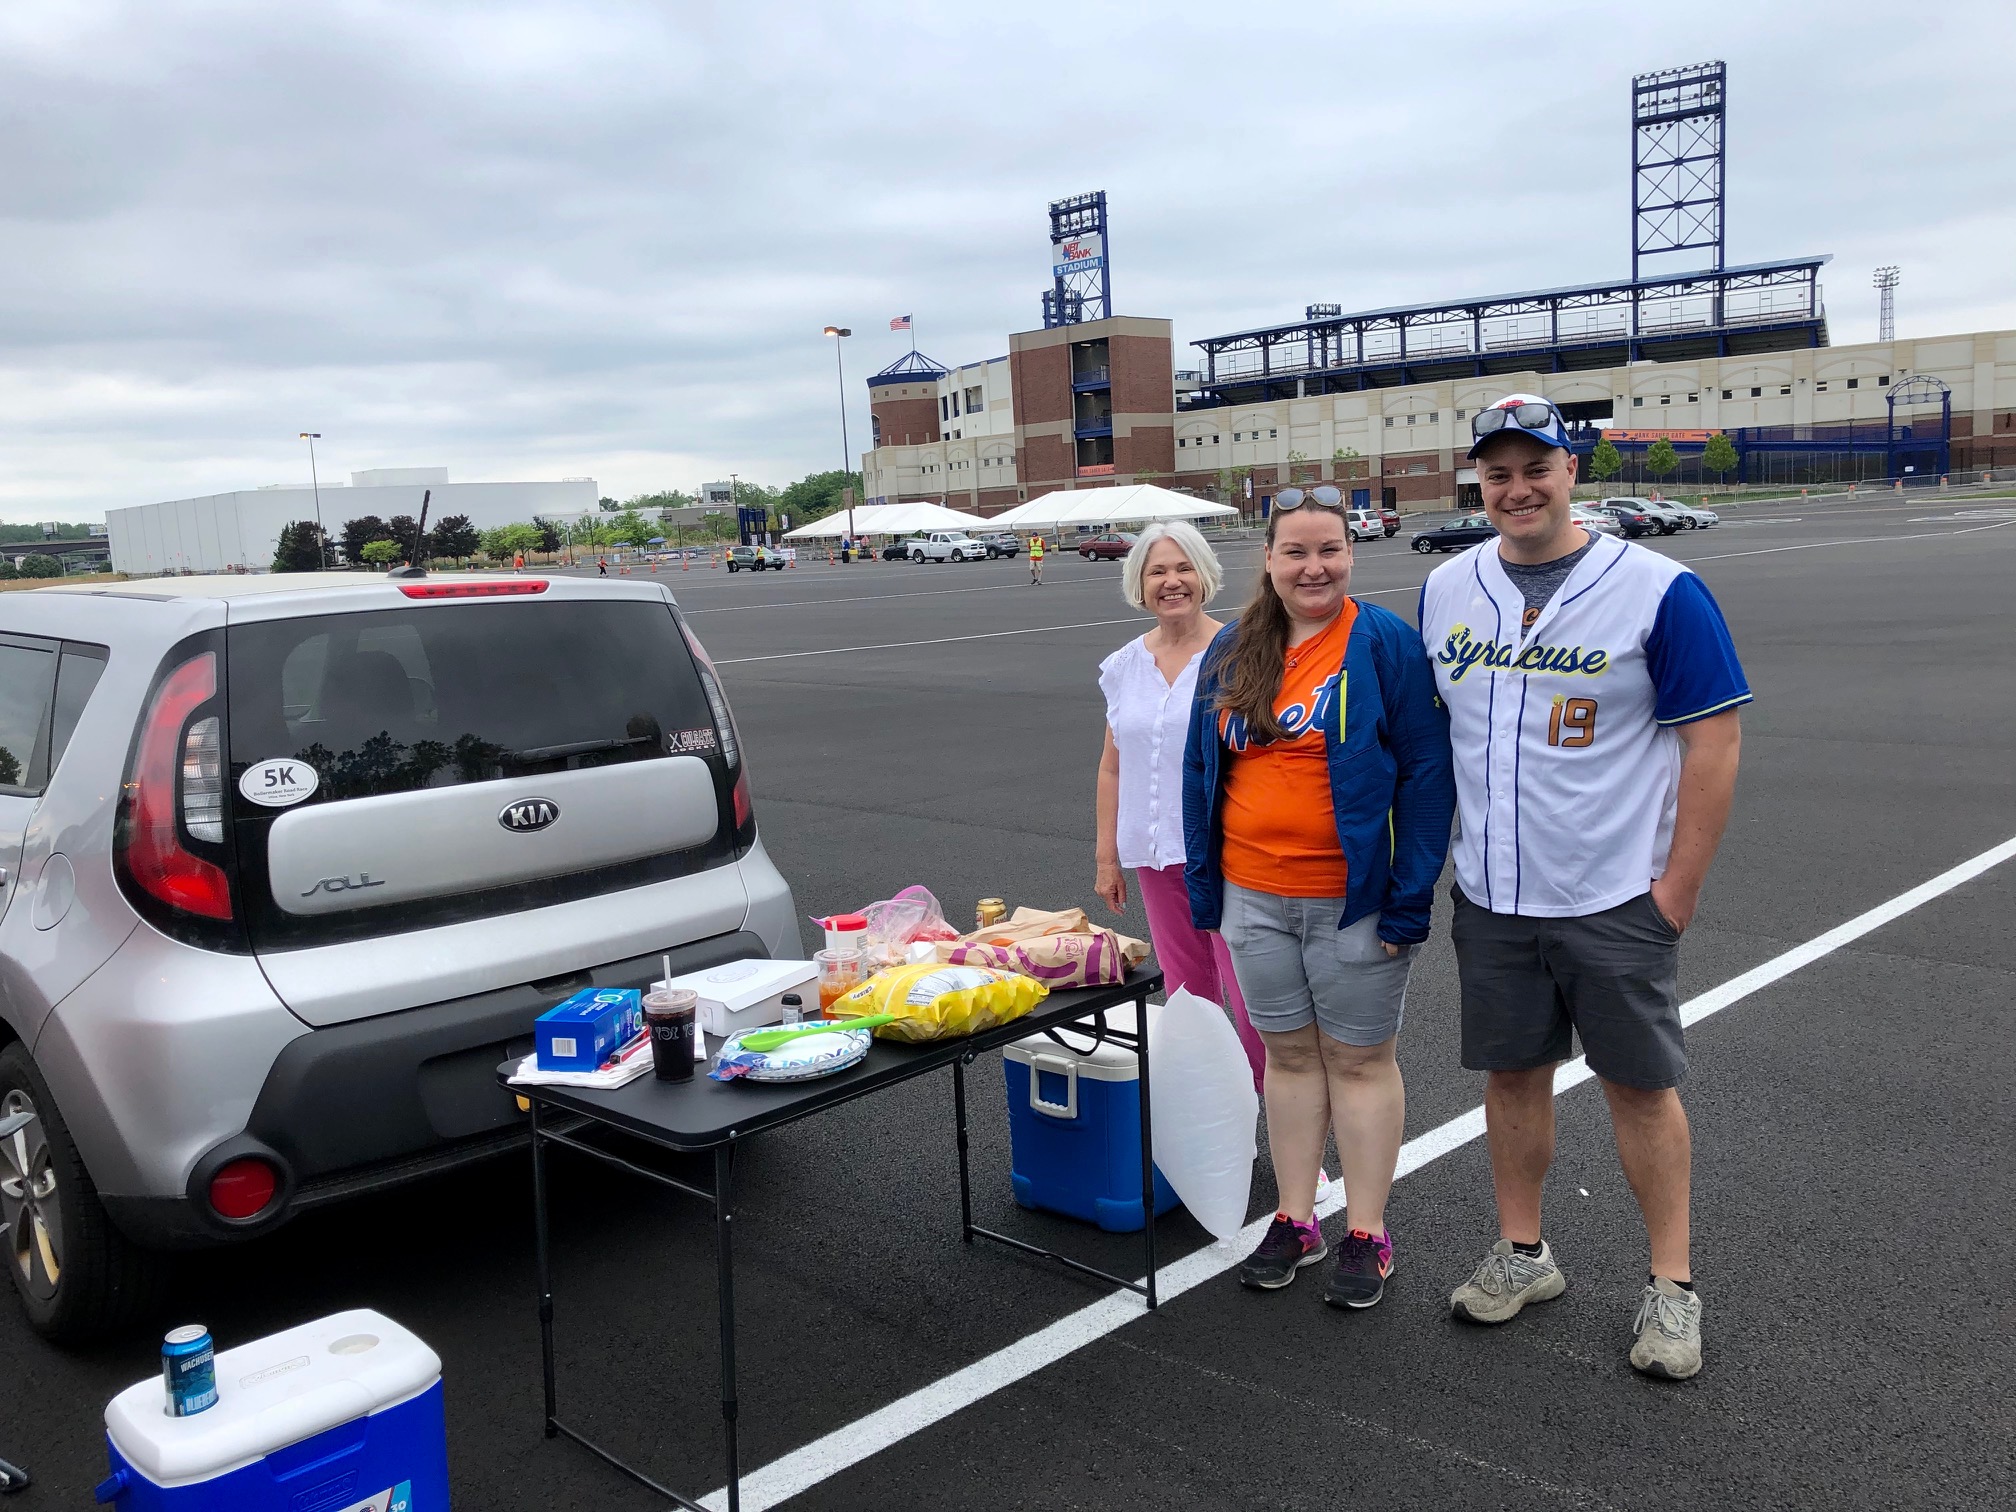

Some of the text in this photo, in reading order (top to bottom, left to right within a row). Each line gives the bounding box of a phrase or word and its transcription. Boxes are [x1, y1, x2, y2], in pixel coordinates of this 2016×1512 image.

[1063, 241, 1081, 253] NBT
[1069, 247, 1092, 261] BANK
[1057, 258, 1098, 274] STADIUM
[1437, 627, 1607, 681] Syracuse
[1548, 697, 1598, 748] 19
[264, 766, 297, 788] 5K
[509, 803, 553, 827] KIA
[852, 985, 873, 1000] CRISPY
[391, 1501, 407, 1512] 30
